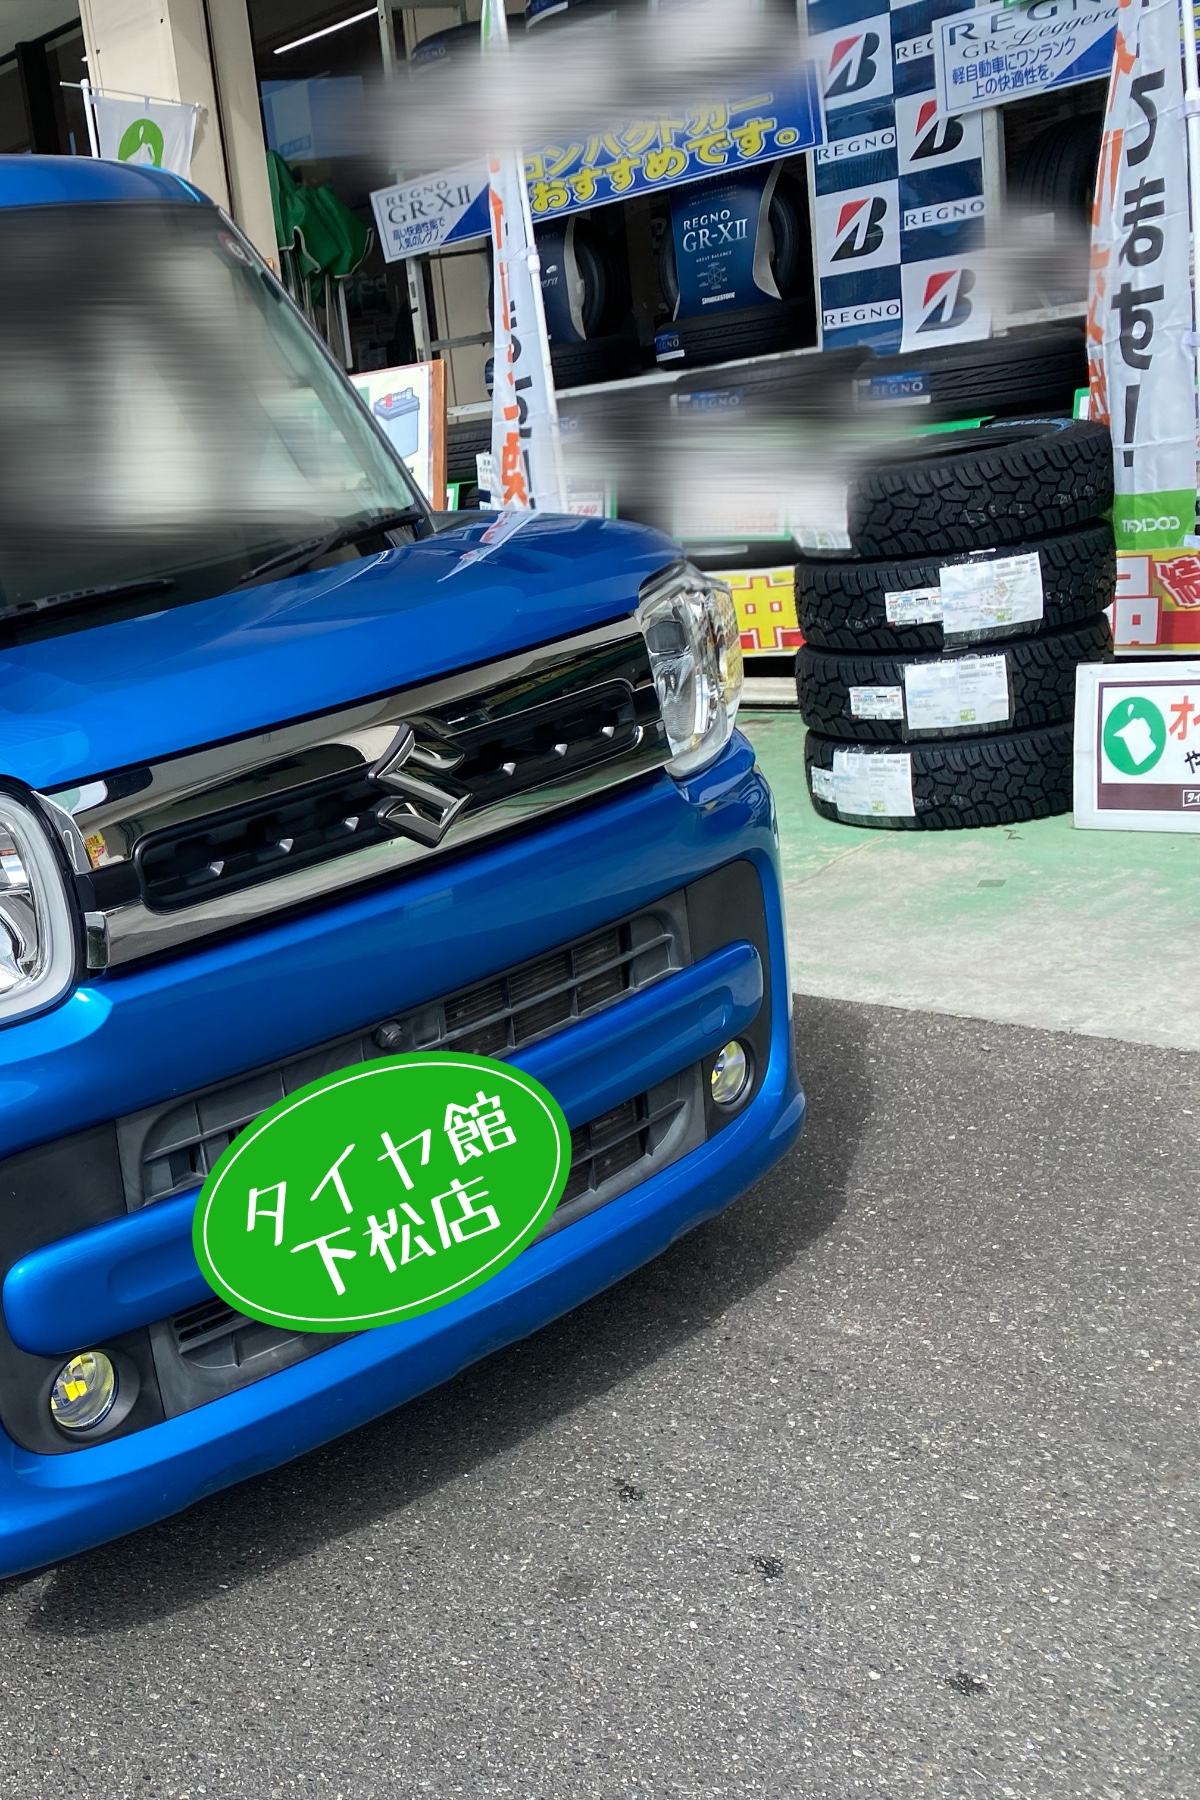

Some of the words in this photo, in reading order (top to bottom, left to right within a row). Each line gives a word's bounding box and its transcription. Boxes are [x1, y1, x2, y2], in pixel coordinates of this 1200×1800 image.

[952, 36, 1077, 86] 軽自動車にワンランク
[972, 64, 1055, 100] 上の快適性を。
[818, 131, 896, 162] REGNO
[531, 116, 799, 213] おすすめです。
[386, 180, 448, 207] REGNO
[683, 209, 731, 231] REGNO
[904, 200, 985, 228] REGNO
[824, 302, 900, 327] REGNO
[1169, 696, 1200, 741] オ
